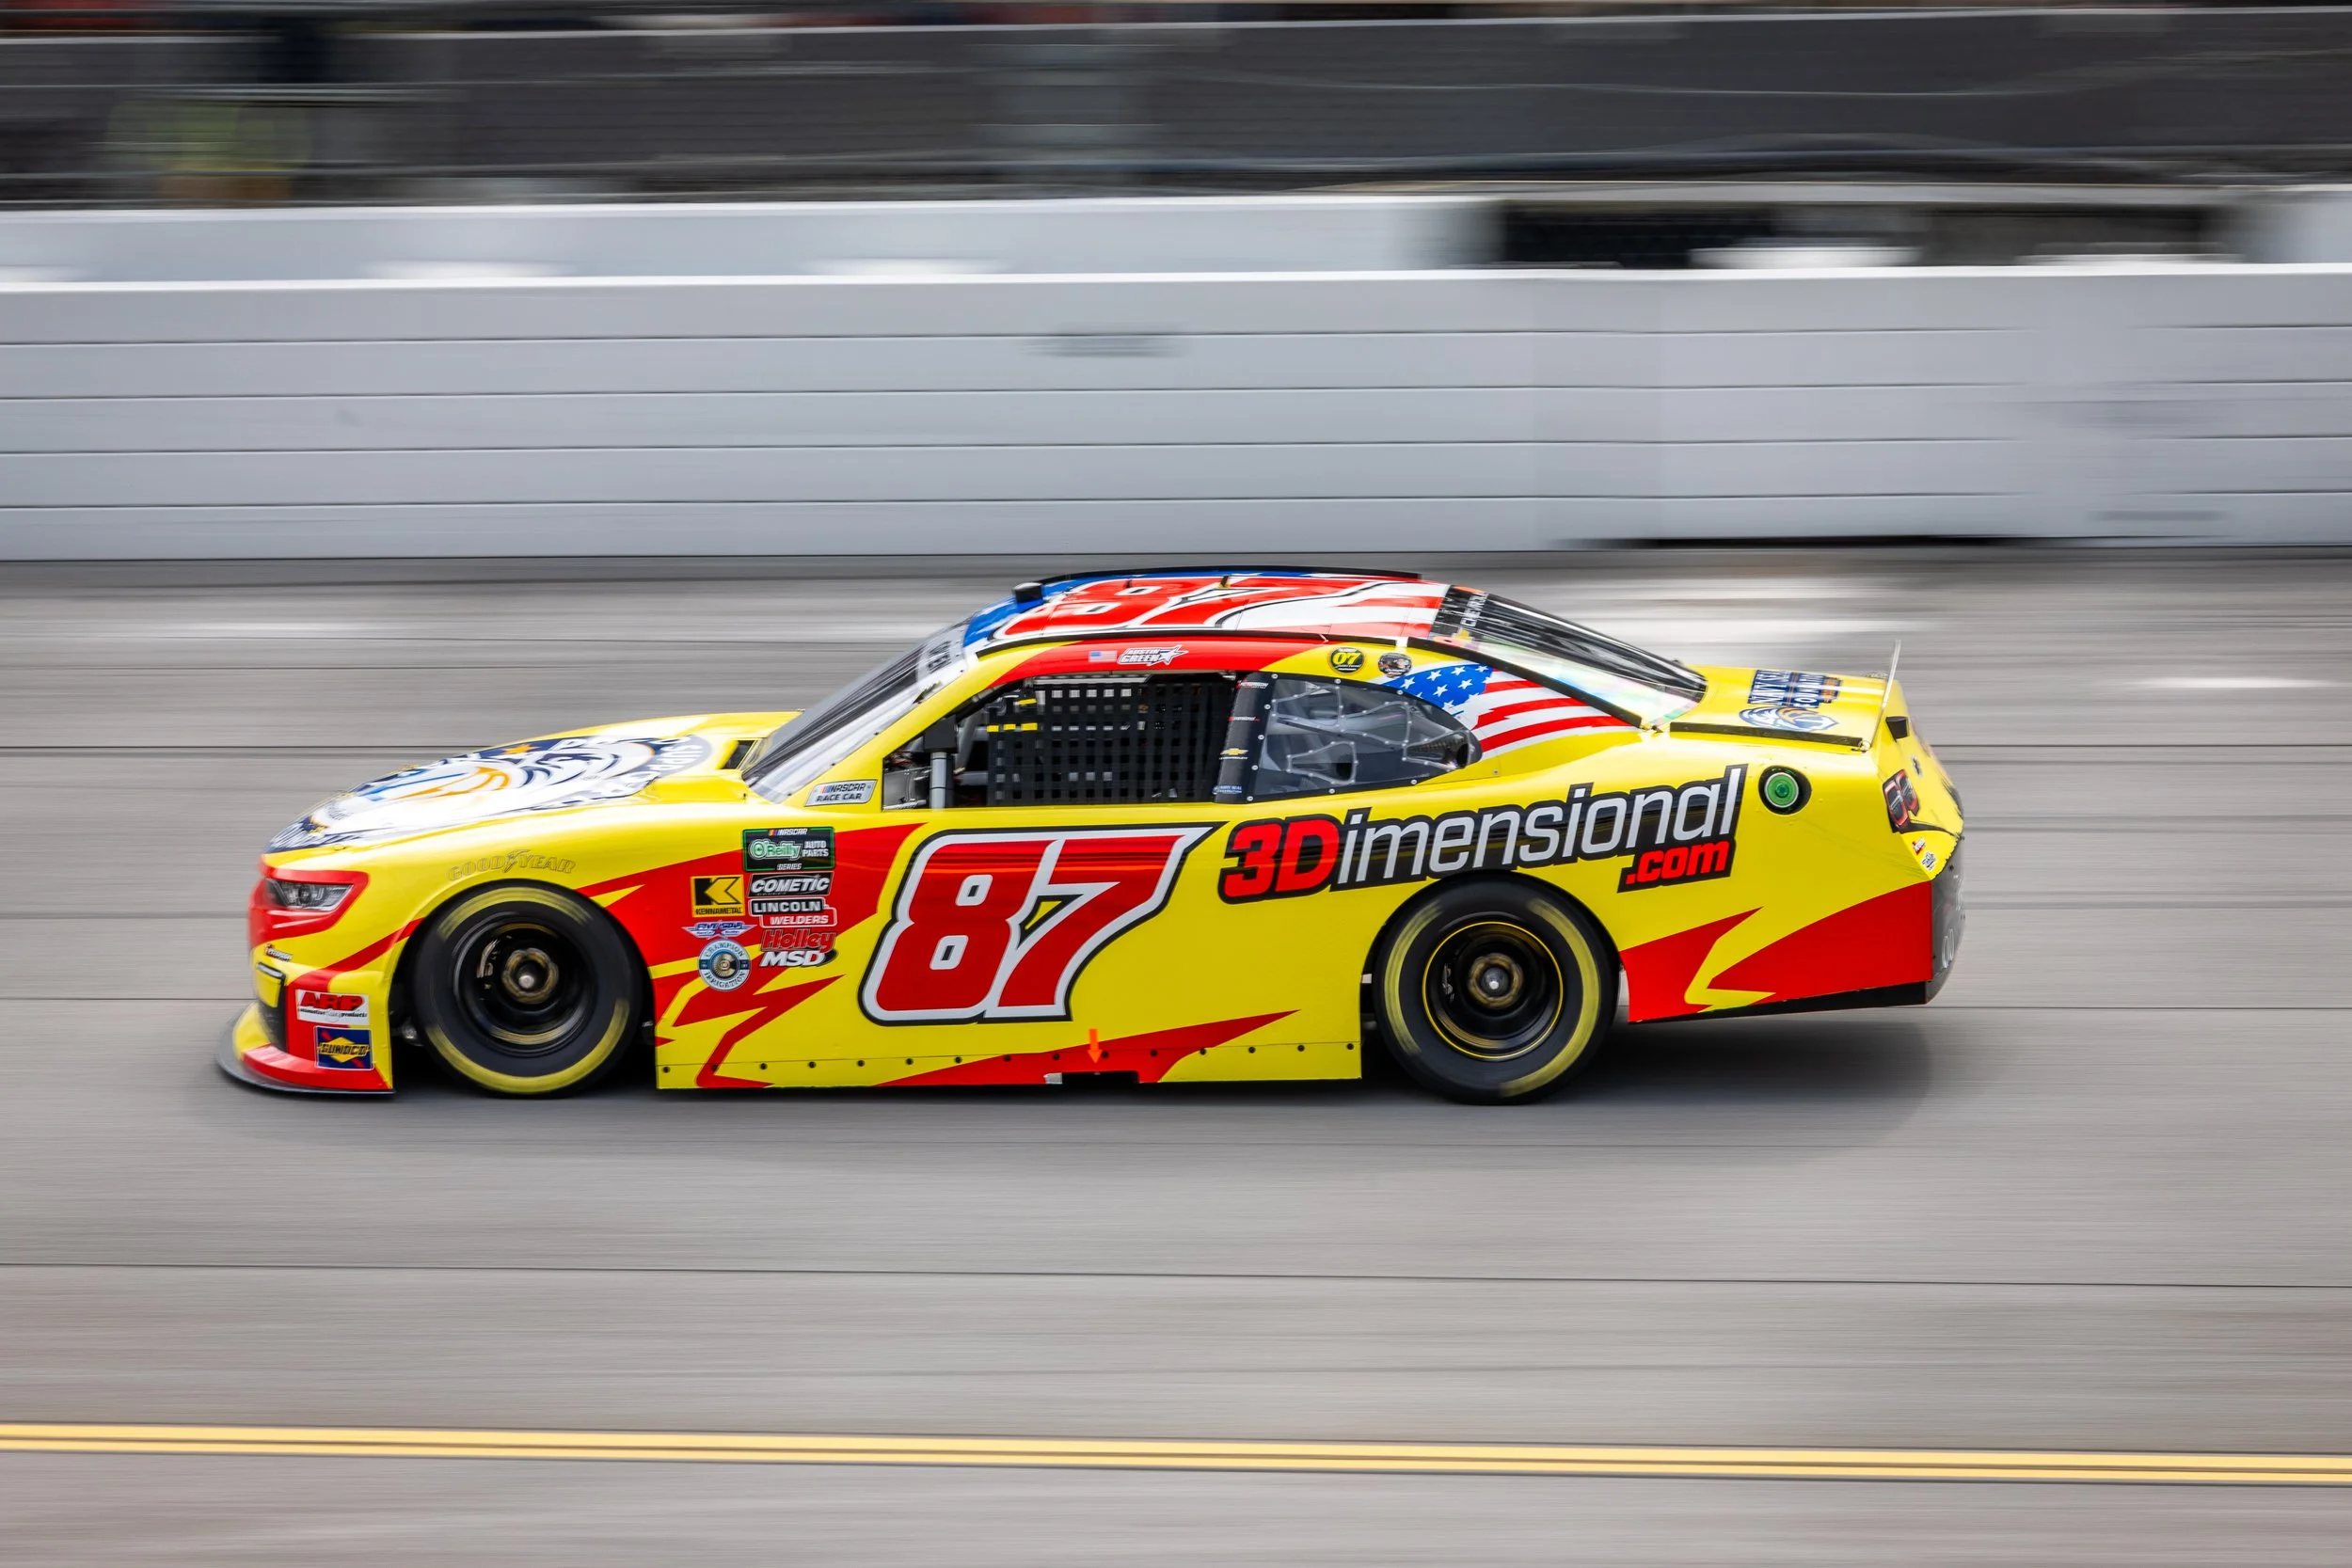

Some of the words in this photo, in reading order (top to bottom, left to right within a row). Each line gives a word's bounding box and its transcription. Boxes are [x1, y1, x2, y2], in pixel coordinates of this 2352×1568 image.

[1332, 652, 1361, 664] 07
[828, 784, 866, 792] NASCAR
[815, 794, 840, 802] RACE
[1223, 768, 1740, 898] 3Dimensional
[803, 840, 827, 848] AUTO
[802, 848, 829, 857] PARTS
[1626, 840, 1731, 883] .com
[750, 877, 830, 894] COMETIC
[753, 900, 821, 913] LINCOLN
[770, 914, 829, 926] WELDERS
[861, 823, 1219, 1024] 87
[760, 928, 836, 954] Holley
[759, 951, 826, 967] MSD
[300, 990, 365, 1011] ARP
[320, 1043, 367, 1056] SUNOCO
